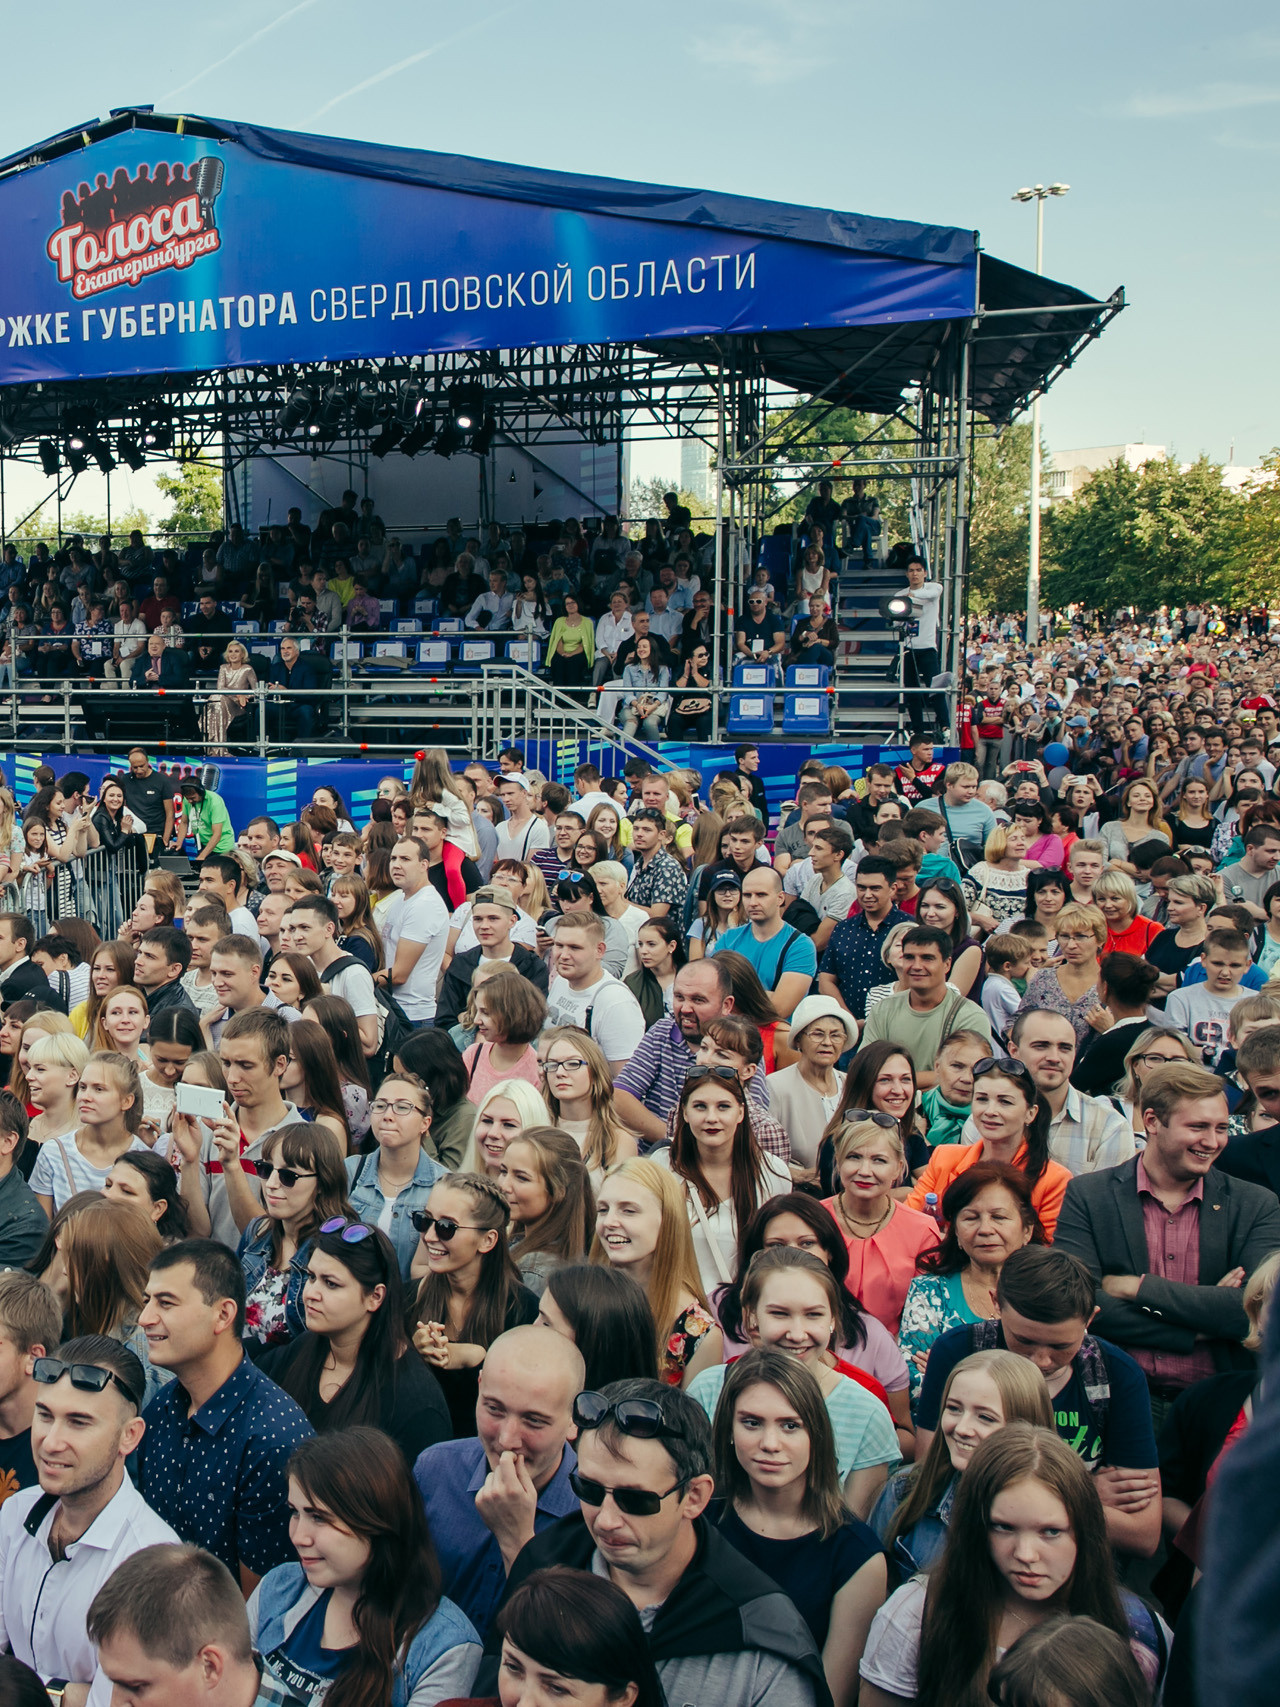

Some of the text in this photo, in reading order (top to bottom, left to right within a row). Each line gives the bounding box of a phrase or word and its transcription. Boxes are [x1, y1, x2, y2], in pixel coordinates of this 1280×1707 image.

[50, 197, 202, 278] Голоса
[76, 232, 216, 295] Екатеринбурга
[82, 291, 298, 342] ГУБЕРНАТОРА
[310, 262, 573, 322] СВЕРДЛОВСКОЙ
[587, 252, 757, 302] ОБЛАСТИ
[1054, 1411, 1079, 1427] ON
[286, 1671, 306, 1689] YOU
